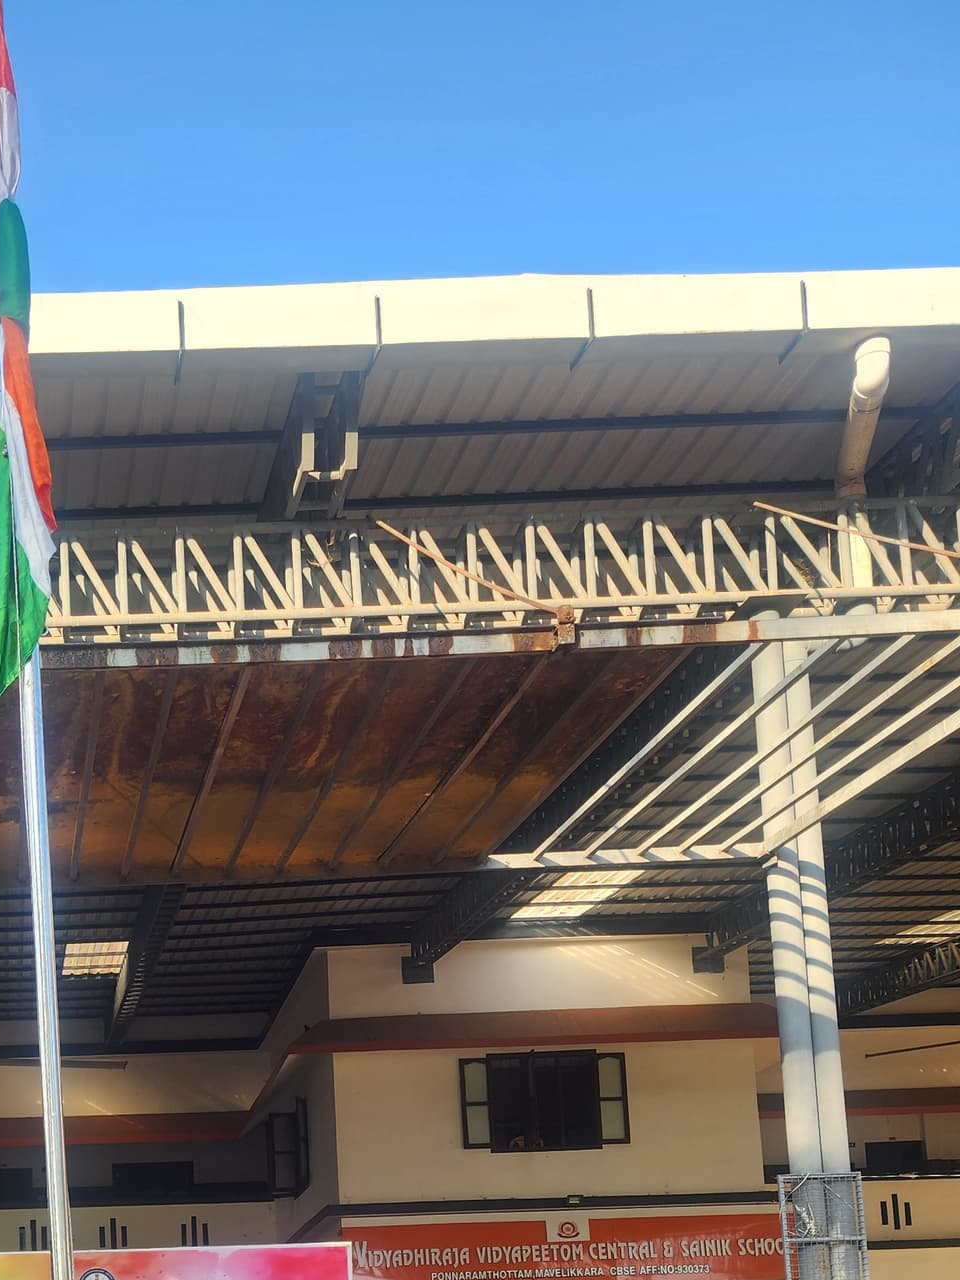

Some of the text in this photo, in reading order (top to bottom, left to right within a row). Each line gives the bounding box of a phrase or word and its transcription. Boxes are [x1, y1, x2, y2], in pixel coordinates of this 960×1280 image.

[354, 1237, 797, 1269] VIDYADHIRAJA VIDYAPEETOM CENTRAL & SAINIK SCHOO
[609, 1264, 636, 1277] CBSE
